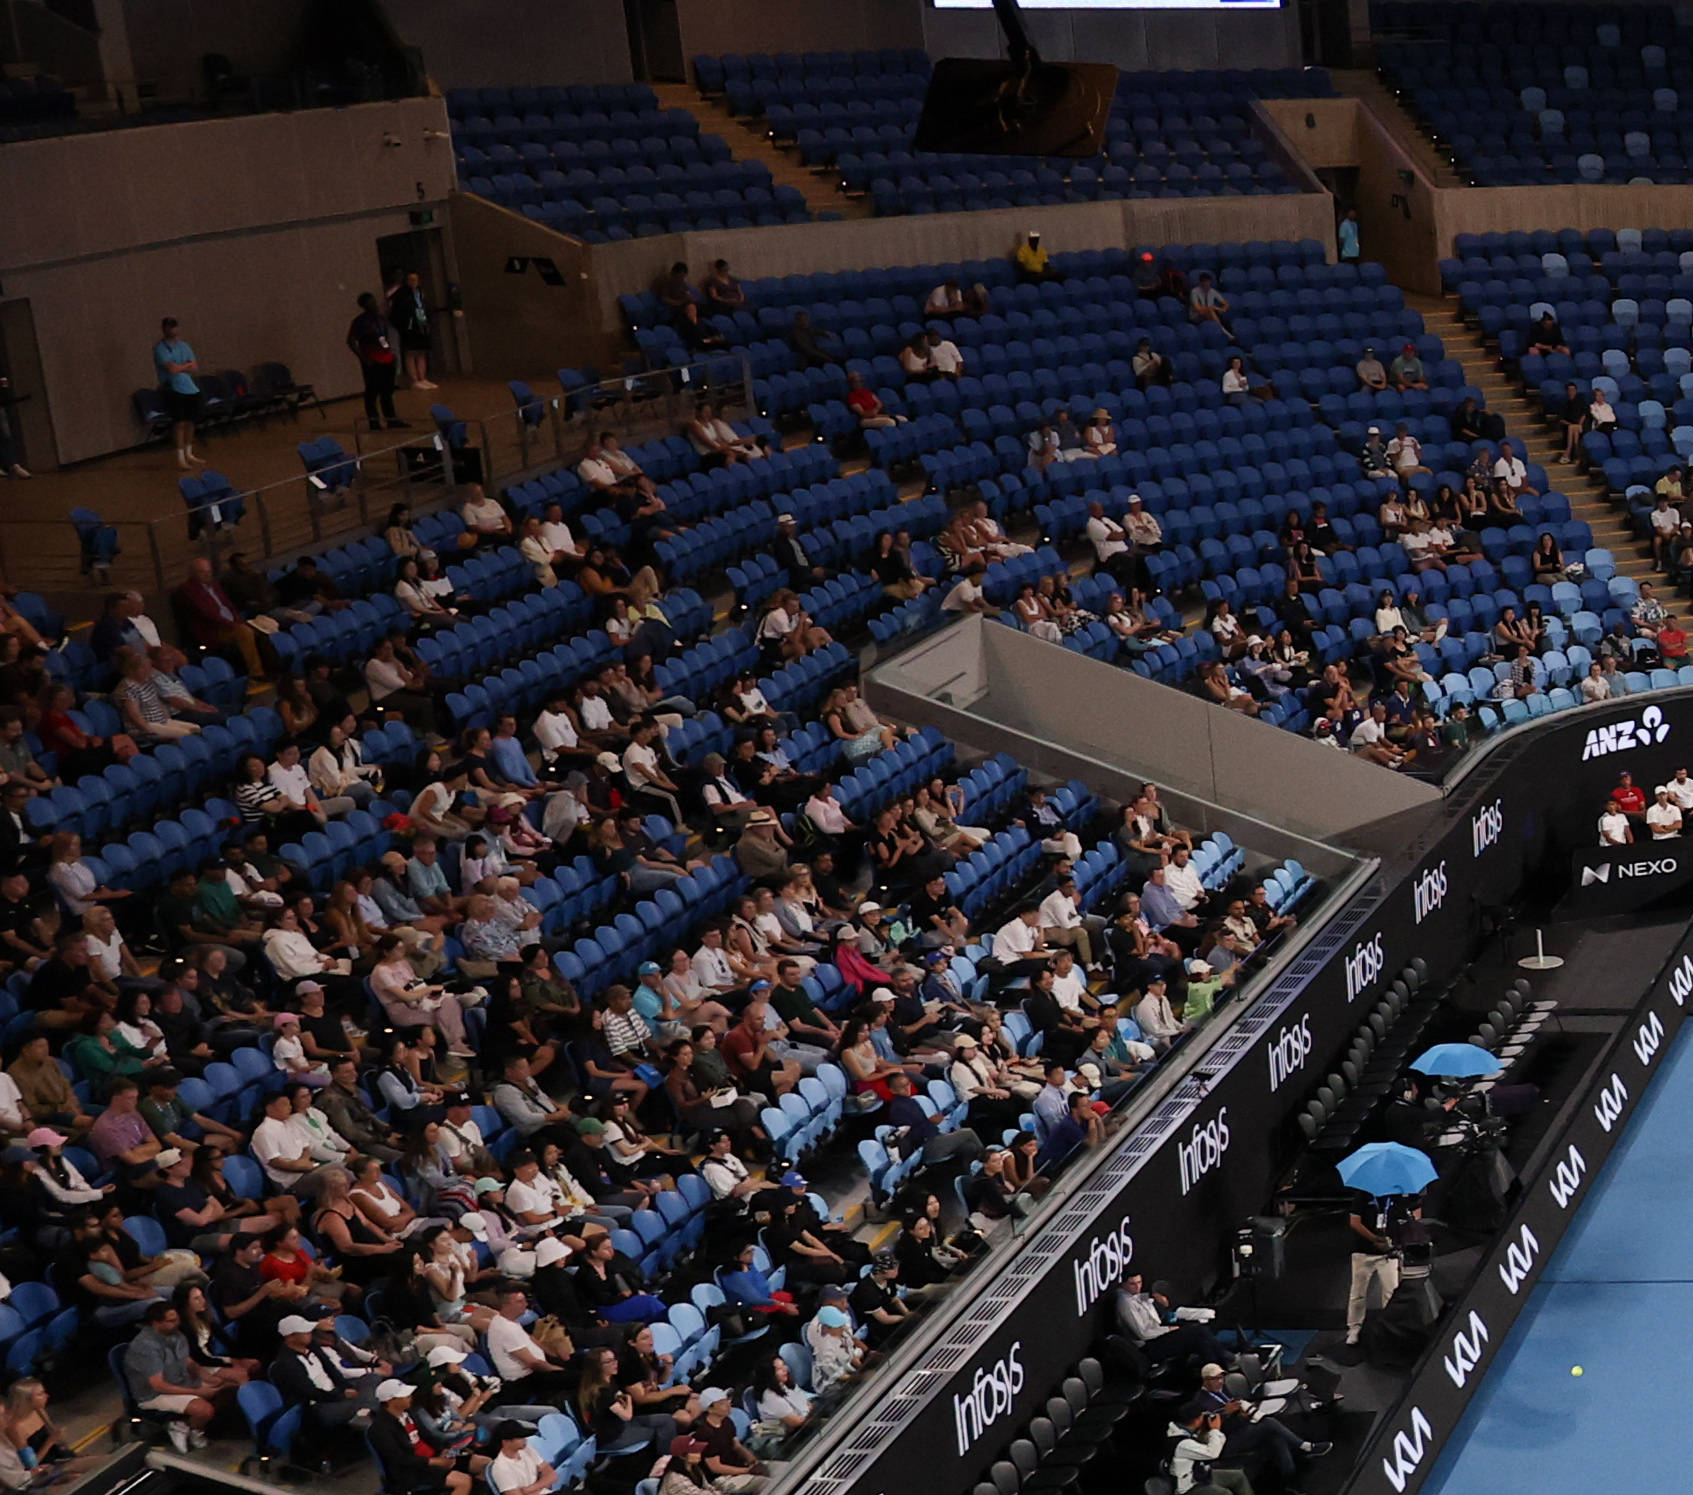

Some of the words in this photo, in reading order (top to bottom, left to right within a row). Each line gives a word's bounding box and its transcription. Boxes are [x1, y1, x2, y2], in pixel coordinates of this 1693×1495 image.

[1582, 719, 1640, 761] ANZ
[1472, 798, 1503, 858] Infosys
[1413, 860, 1447, 925] Infosys
[1618, 858, 1677, 879] NEXO
[1345, 931, 1384, 1003] Infosys
[1268, 1013, 1312, 1092] Infosys
[1178, 1106, 1229, 1196] Infosys
[1073, 1215, 1133, 1317] Infosys
[953, 1341, 1024, 1457] Infosys
